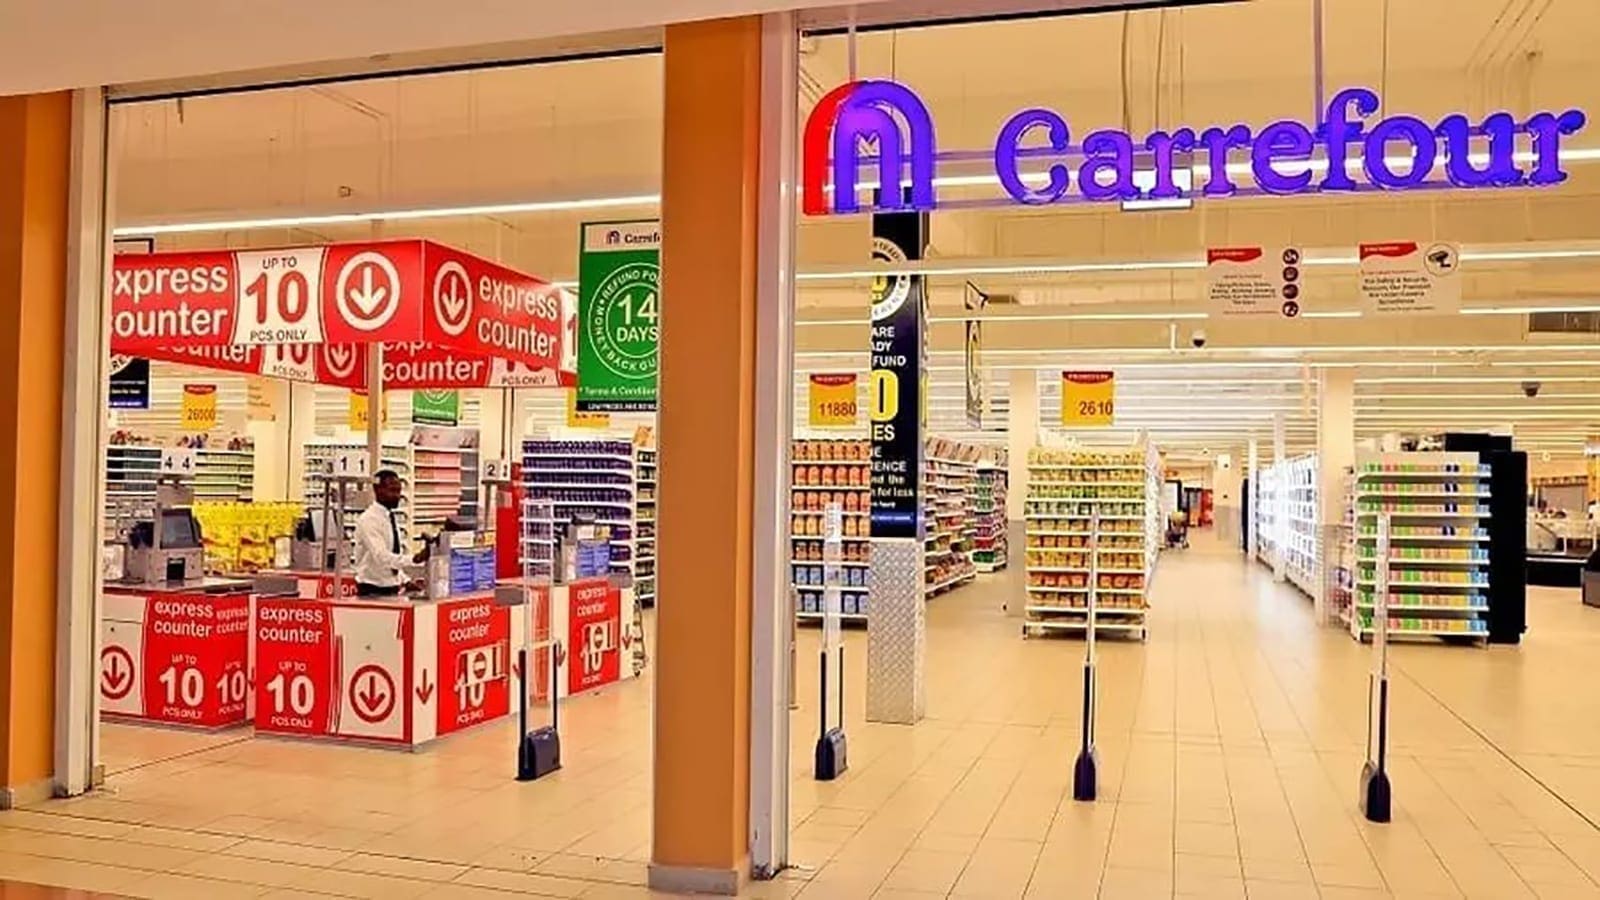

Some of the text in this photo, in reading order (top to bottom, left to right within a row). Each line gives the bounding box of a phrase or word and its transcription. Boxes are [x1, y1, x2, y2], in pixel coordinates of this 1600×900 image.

[995, 88, 1586, 205] Carrefour
[262, 256, 298, 269] UP TO
[113, 266, 229, 303] xpress
[602, 270, 640, 299] REFUND
[245, 271, 309, 324] 10
[479, 275, 558, 321] express
[618, 293, 658, 325] 14
[112, 302, 229, 338] ounter
[250, 329, 308, 342] PCS ONLY
[478, 318, 558, 358] counter
[616, 326, 659, 342] DAYS
[383, 355, 484, 382] counter
[607, 350, 638, 371] BACK
[487, 463, 497, 477] 2
[154, 600, 214, 619] express
[260, 606, 324, 624] express
[449, 604, 491, 624] express
[153, 620, 212, 638] counter
[259, 626, 324, 644] counter
[449, 622, 490, 643] counter
[185, 655, 198, 665] TO
[293, 661, 306, 672] TO
[159, 666, 204, 707] 10
[216, 670, 245, 704] 10
[266, 673, 315, 716] 10
